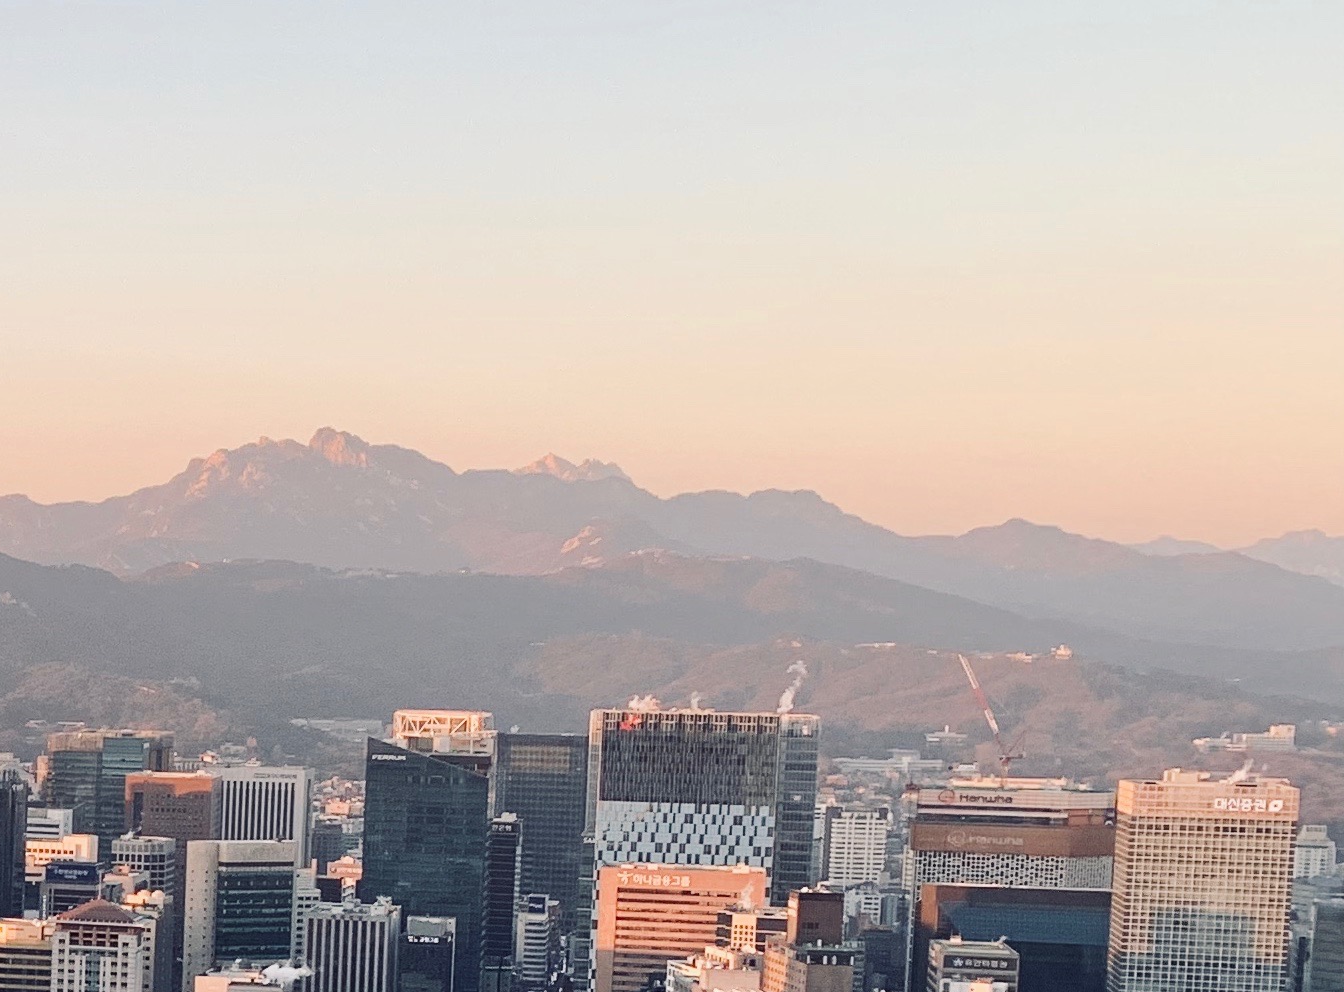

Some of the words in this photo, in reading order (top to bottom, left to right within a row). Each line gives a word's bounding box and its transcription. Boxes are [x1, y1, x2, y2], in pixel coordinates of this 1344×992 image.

[960, 794, 1013, 803] Hanwha
[1214, 798, 1266, 811] 대신증권
[969, 834, 1024, 846] Hanwha
[632, 873, 691, 887] 하나금융그룹
[964, 959, 1009, 969] 유안타증권
